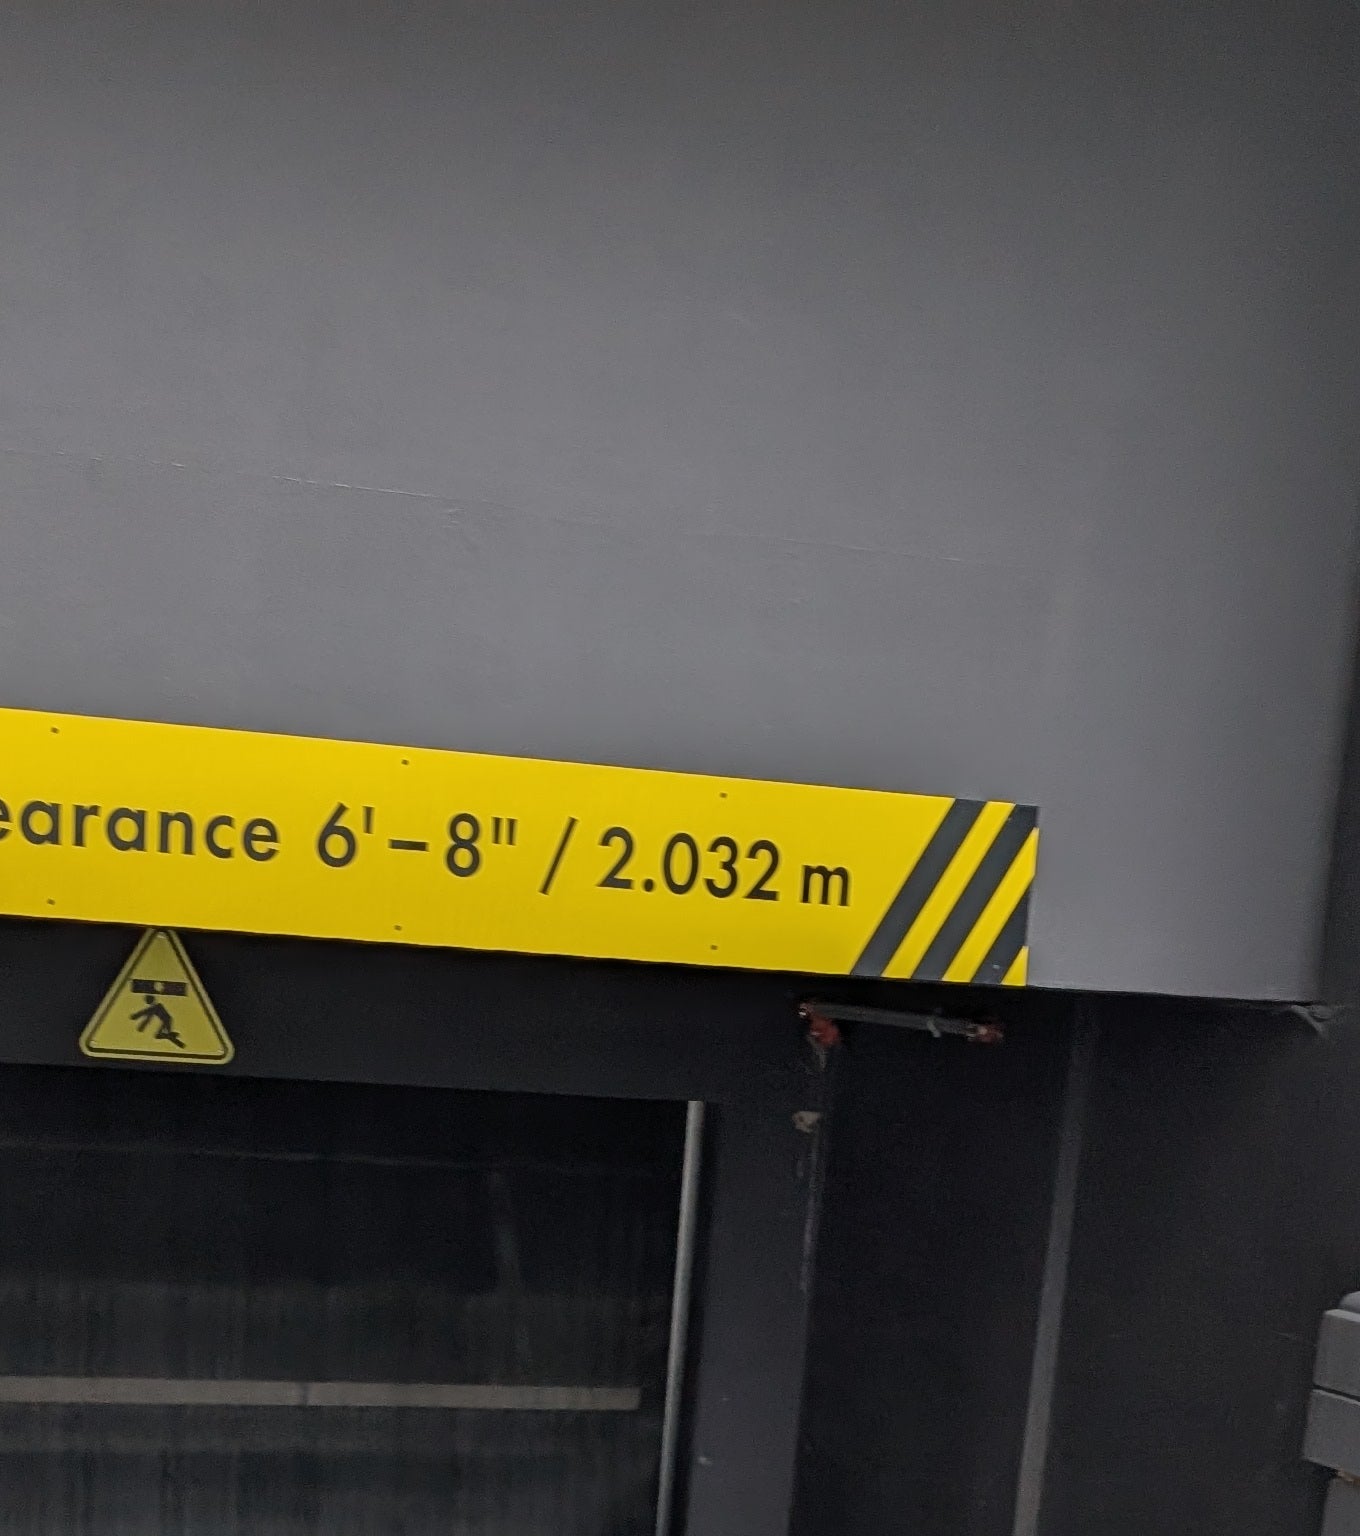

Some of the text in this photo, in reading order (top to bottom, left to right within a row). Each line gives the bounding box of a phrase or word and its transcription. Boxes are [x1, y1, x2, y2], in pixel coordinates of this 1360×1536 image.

[539, 816, 578, 896] /
[597, 825, 781, 903] 2.032
[800, 863, 850, 908] m
